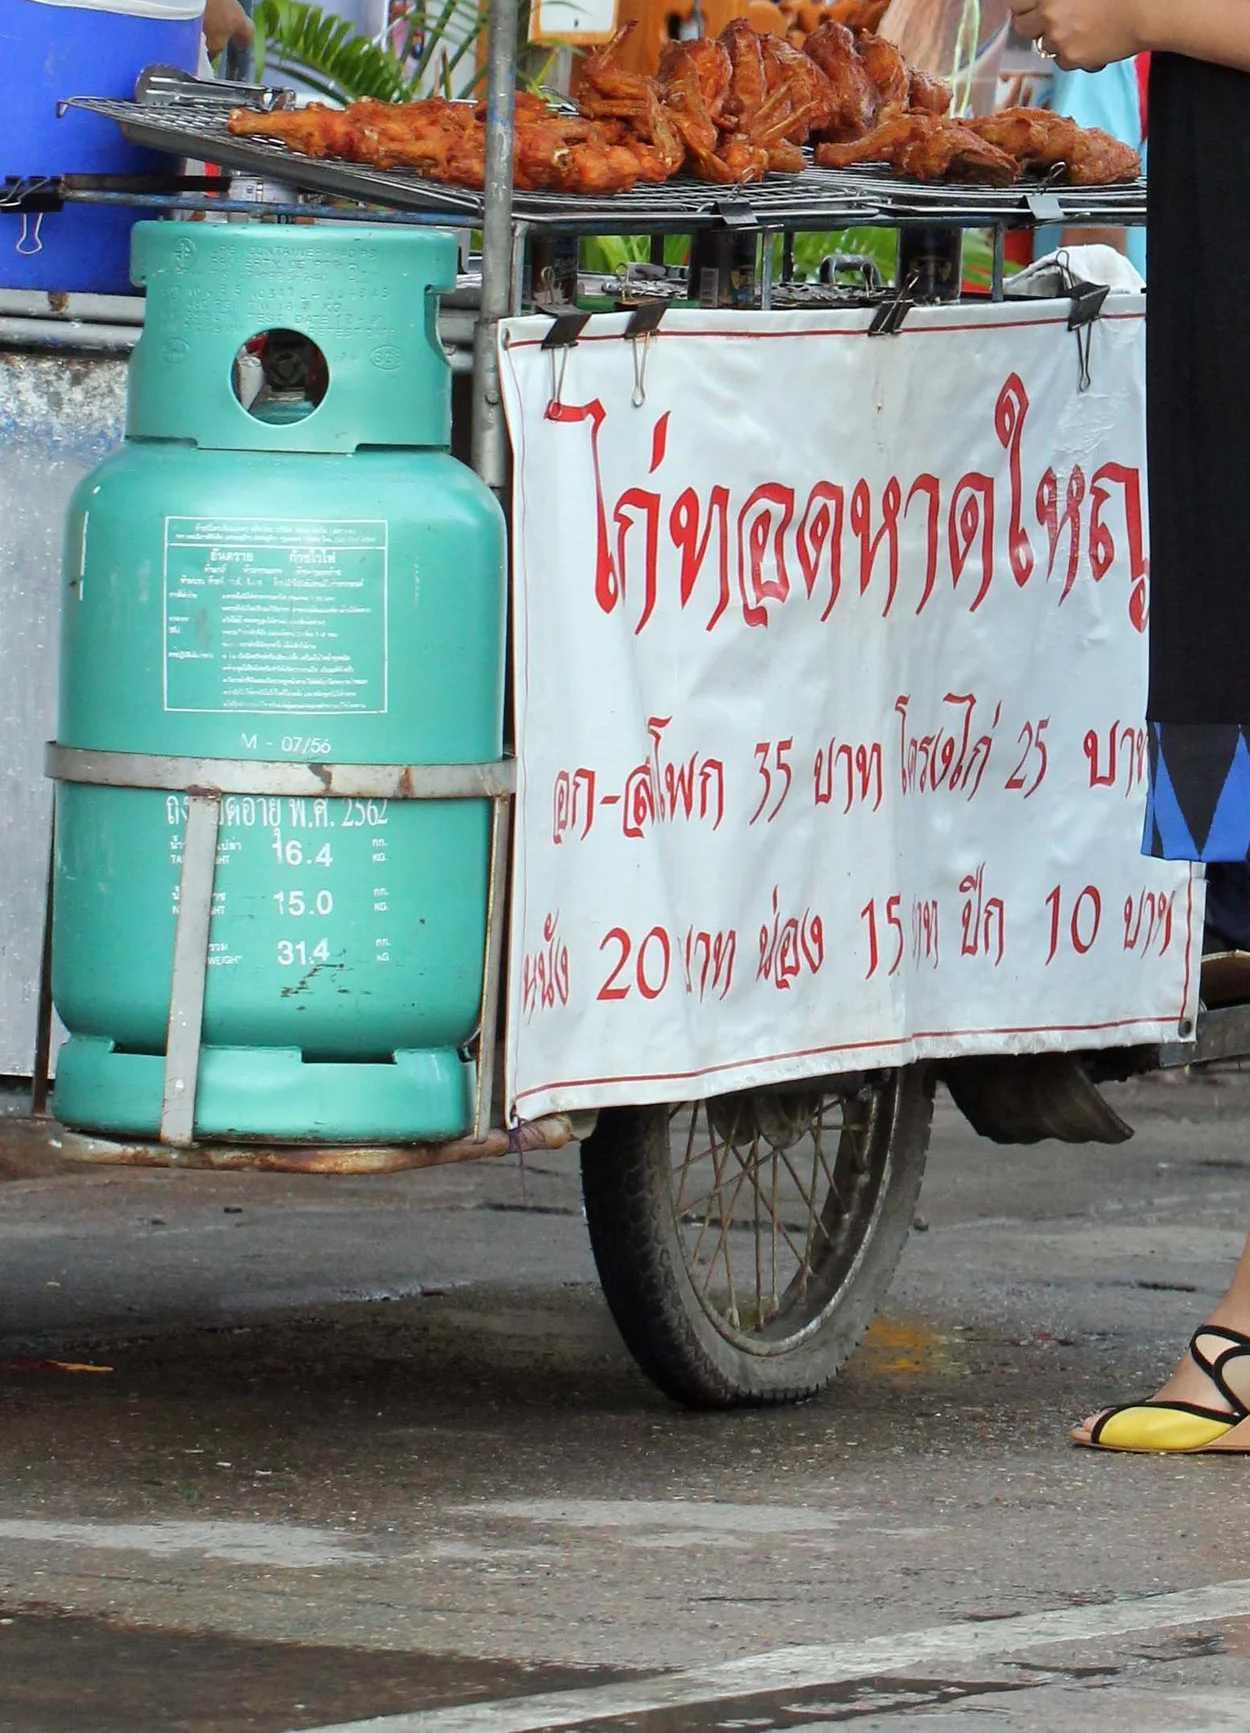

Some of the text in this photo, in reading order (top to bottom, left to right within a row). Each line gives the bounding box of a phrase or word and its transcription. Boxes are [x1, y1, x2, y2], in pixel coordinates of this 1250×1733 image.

[749, 736, 795, 827] 35
[812, 736, 884, 815] บาท
[1003, 714, 1051, 800] 25
[271, 840, 334, 868] 16.4
[273, 889, 334, 917] 15.0
[595, 925, 672, 1001] 20
[755, 884, 825, 991] น่อง
[860, 892, 905, 981] 15
[958, 862, 1005, 968] ปีก
[1044, 884, 1102, 967] 10
[1122, 884, 1178, 960] บาท
[276, 936, 331, 966] 31.4
